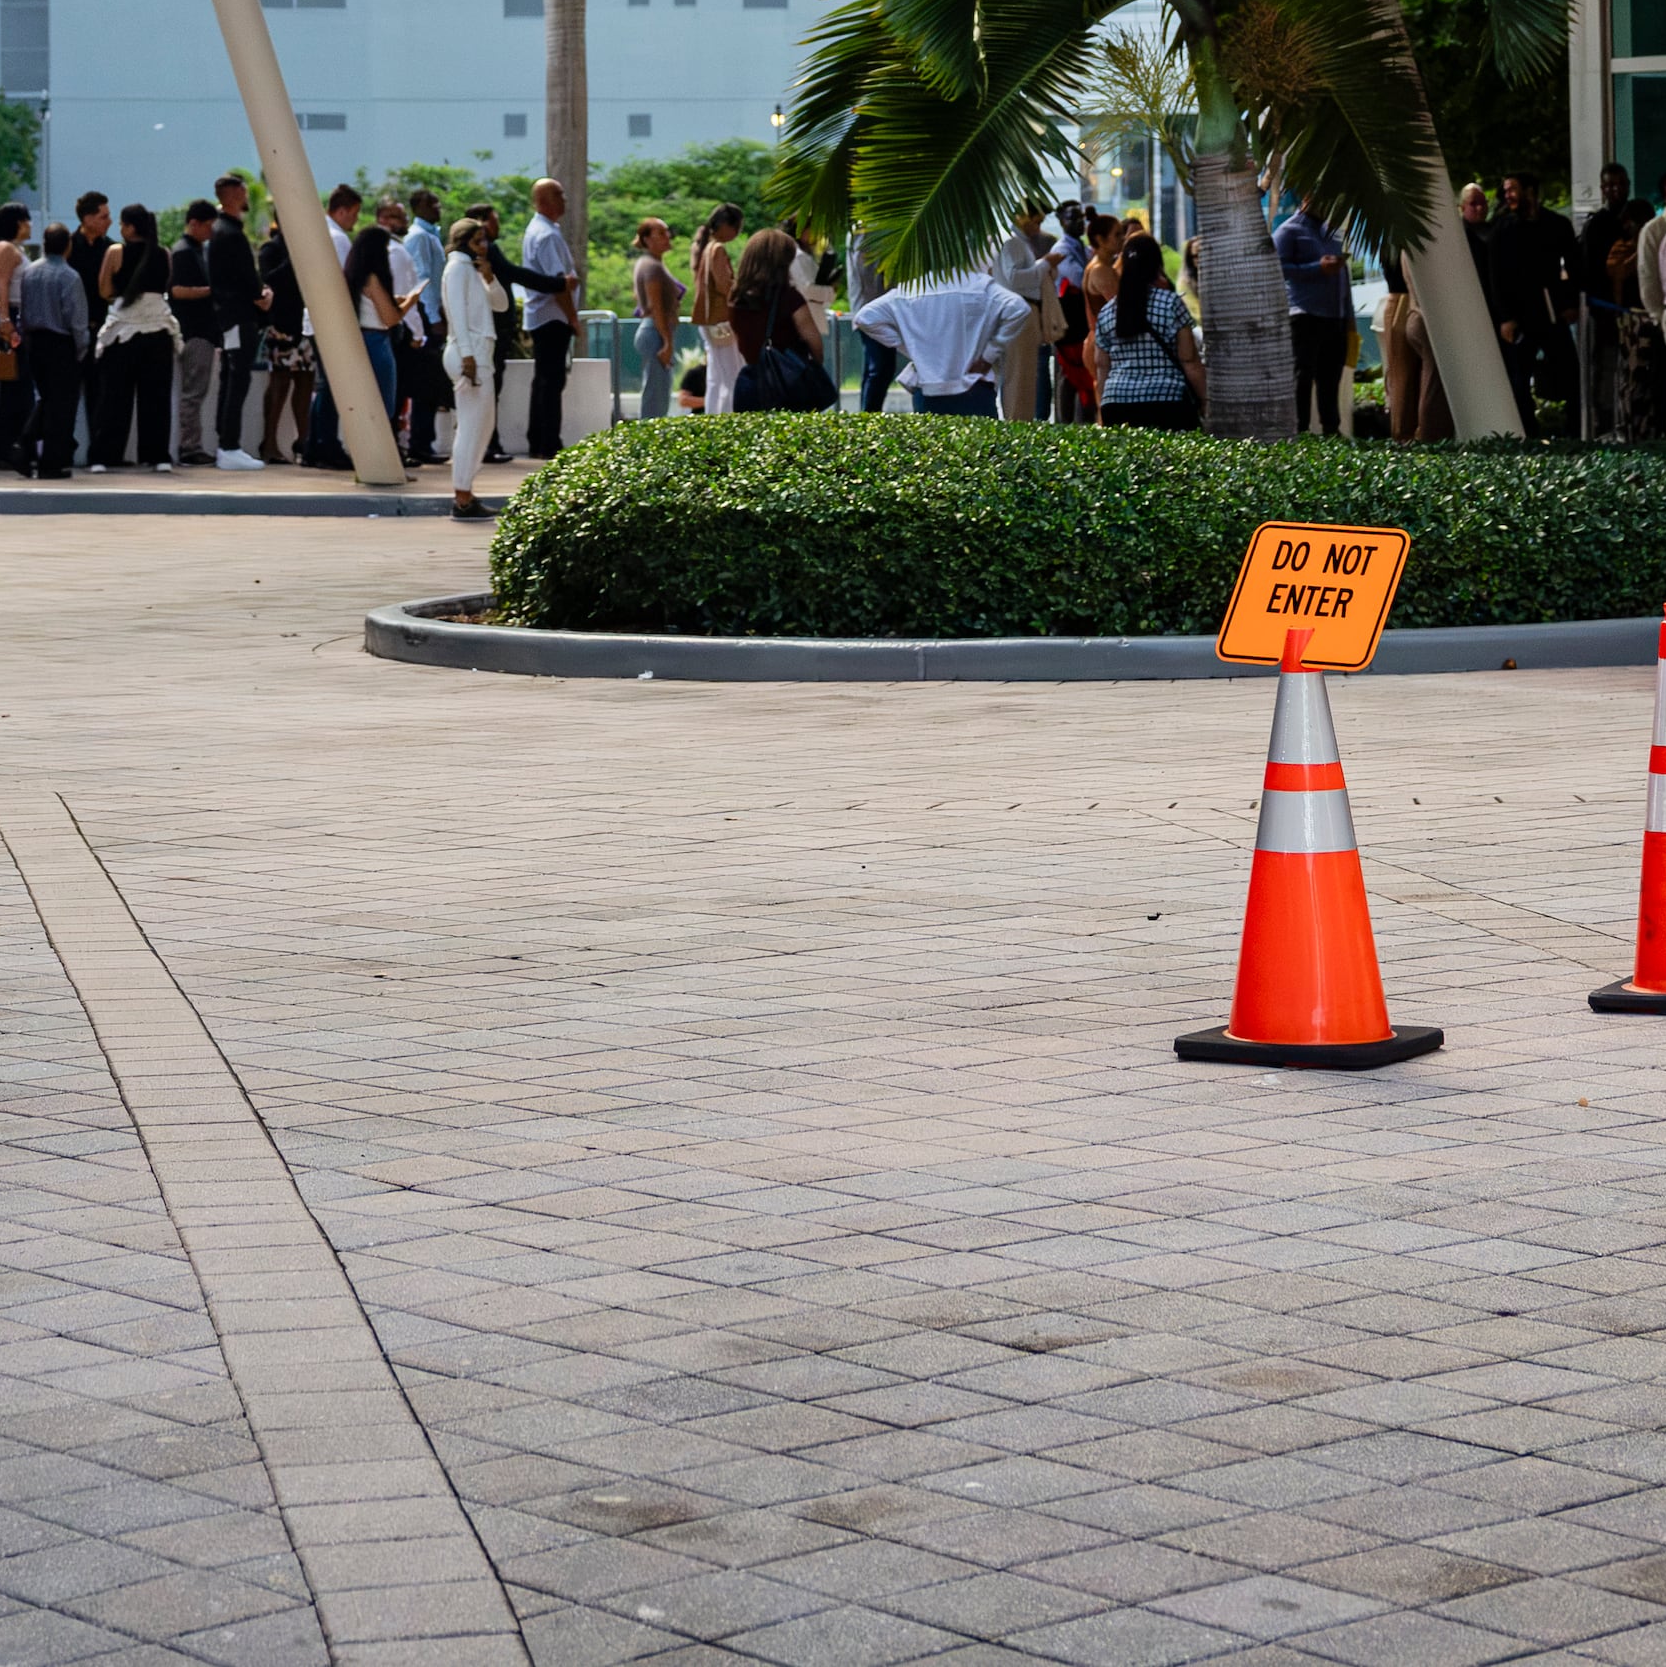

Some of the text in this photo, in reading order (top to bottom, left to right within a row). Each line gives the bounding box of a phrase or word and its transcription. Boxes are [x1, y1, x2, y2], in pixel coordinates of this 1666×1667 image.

[1271, 540, 1379, 576] DO NOT
[1266, 583, 1354, 619] ENTER
